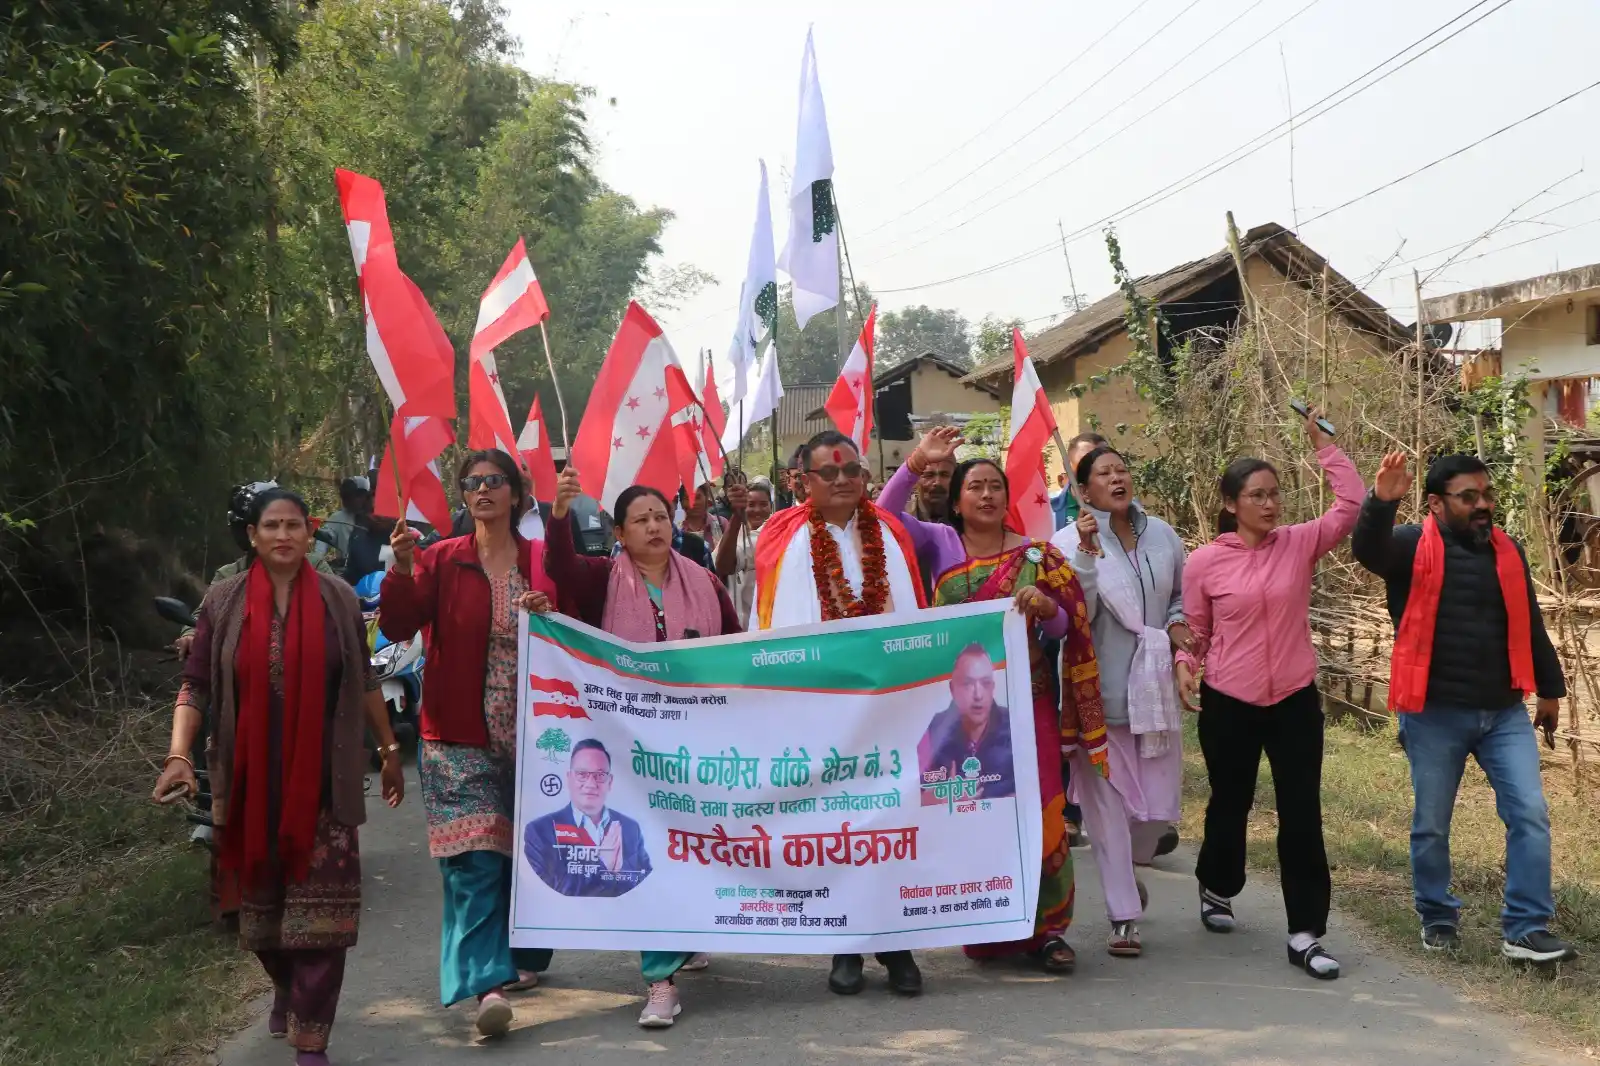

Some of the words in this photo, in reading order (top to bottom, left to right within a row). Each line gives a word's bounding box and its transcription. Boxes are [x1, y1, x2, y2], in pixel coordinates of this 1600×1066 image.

[882, 634, 932, 654] समाजवाद
[752, 649, 806, 667] लोकतन्त्र
[583, 683, 604, 696] अमर
[606, 686, 622, 701] सिंह
[587, 699, 617, 712] उज्यालो
[619, 704, 657, 719] भविष्यको
[660, 710, 681, 720] आशा
[631, 740, 691, 784] नेपाली
[697, 746, 762, 791] कांग्रेस,
[821, 747, 859, 785] क्षेत्र
[864, 744, 883, 778] नं.
[890, 749, 902, 779] ३
[648, 790, 696, 814] प्रतिनिधि
[700, 801, 728, 817] सभा
[732, 802, 775, 818] सदस्य
[779, 797, 816, 814] पदका
[821, 788, 900, 812] उम्मेदवारको
[566, 845, 600, 862] अमर
[668, 823, 772, 868] घरदैलो
[782, 821, 919, 867] कार्यक्रम
[786, 889, 812, 899] मतदान
[815, 886, 830, 899] गरी
[900, 884, 933, 900] निर्वाचन
[936, 883, 958, 897] प्रचार
[960, 881, 982, 895] प्रसार
[985, 875, 1013, 891] समिति
[971, 897, 992, 911] समिति
[756, 916, 779, 926] मतका
[781, 917, 797, 927] साथ
[800, 914, 821, 927] विजय
